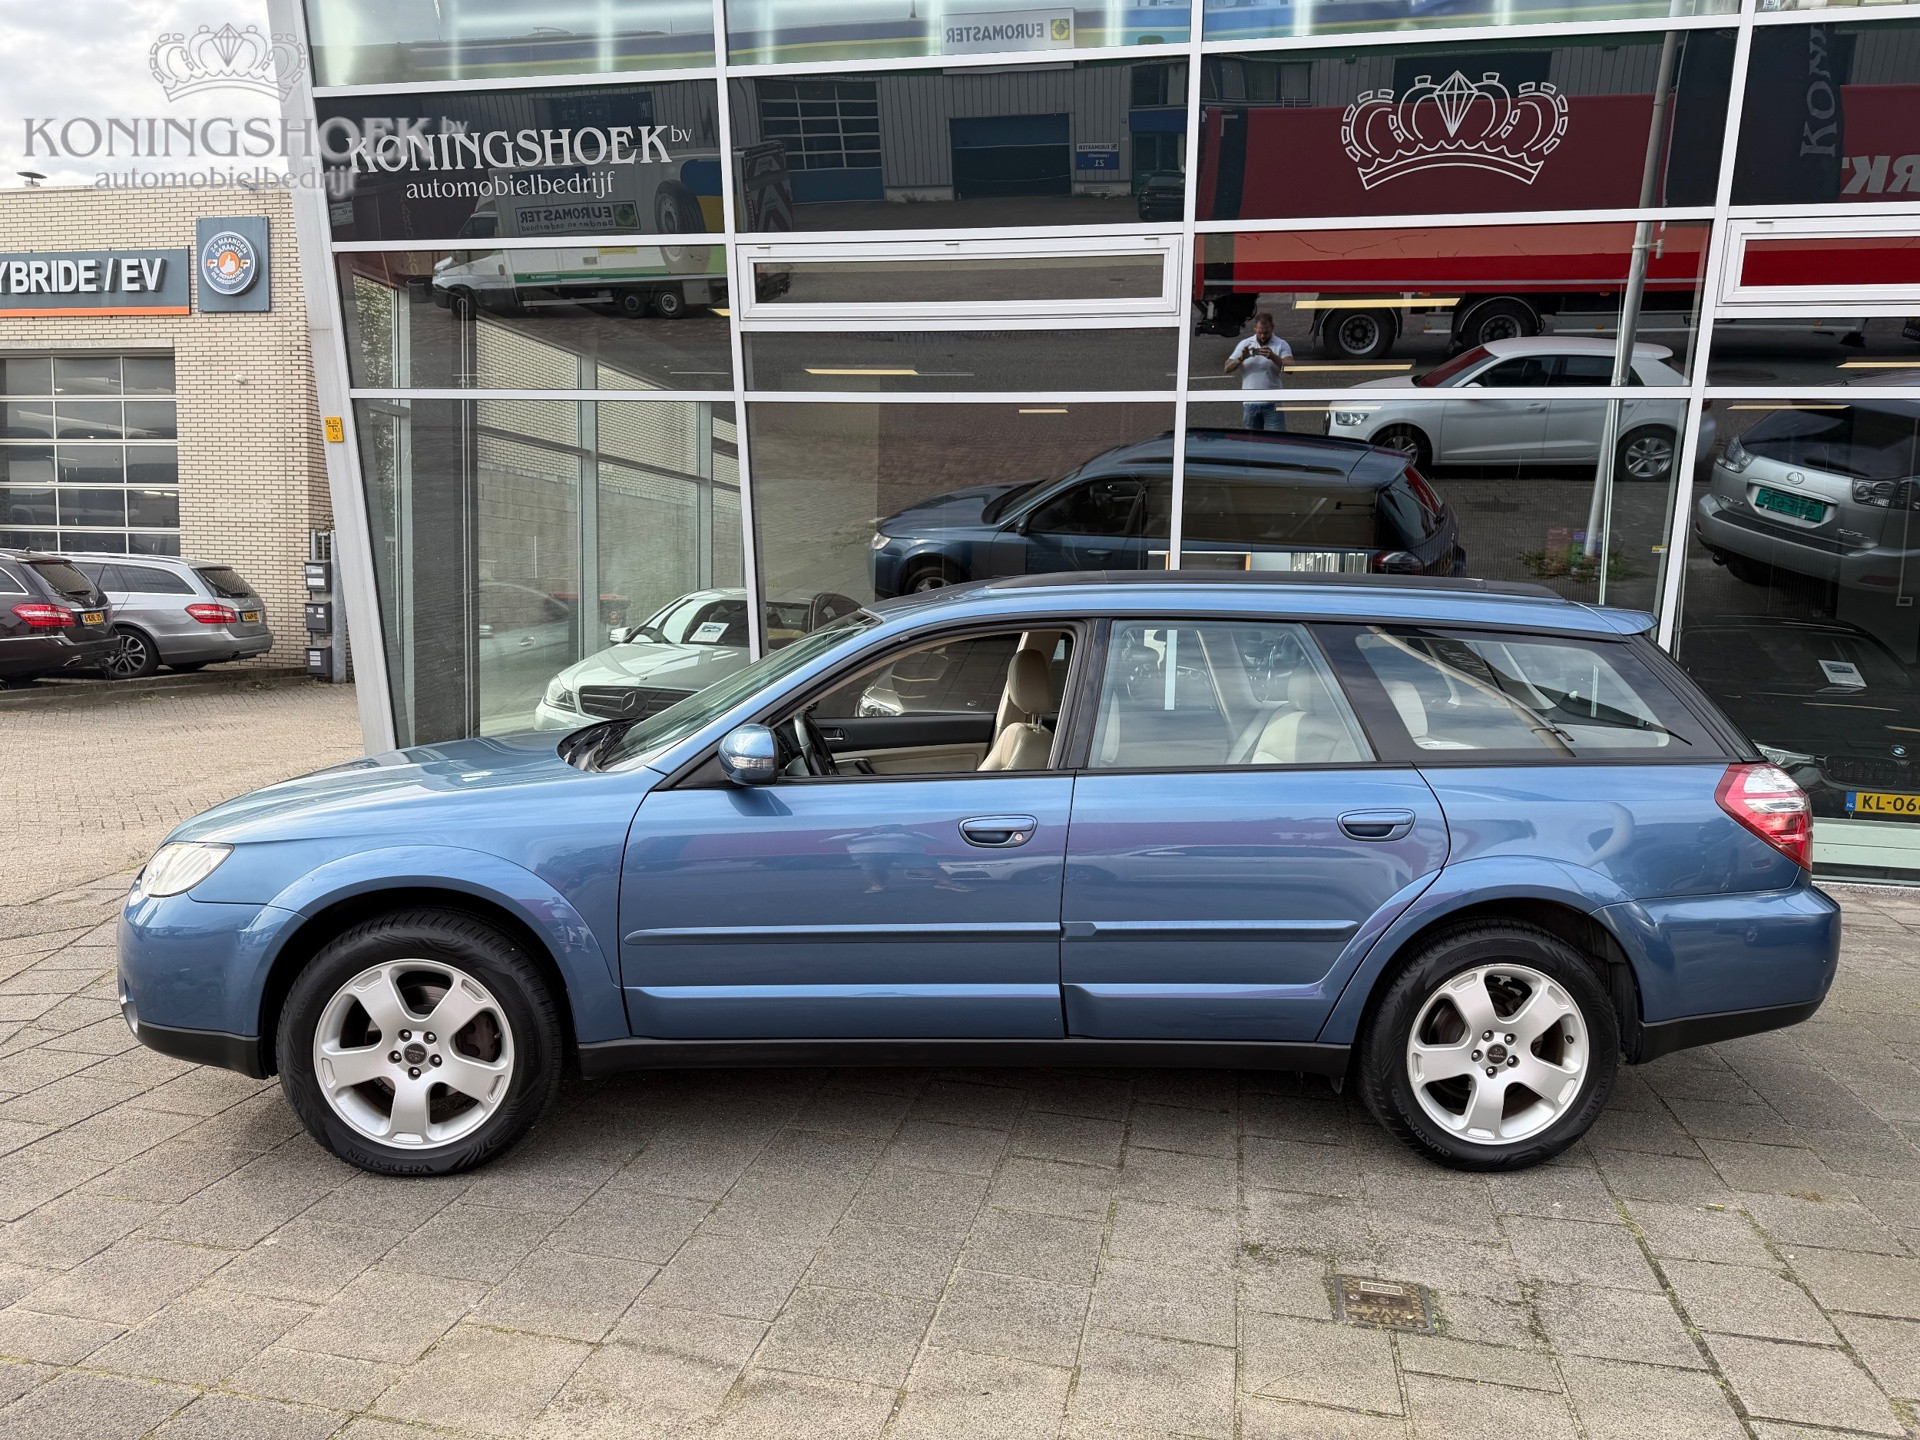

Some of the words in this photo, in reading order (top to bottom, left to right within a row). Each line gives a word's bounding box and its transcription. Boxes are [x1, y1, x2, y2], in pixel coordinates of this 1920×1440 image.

[345, 125, 672, 173] KONINGSHOEK
[671, 125, 692, 142] bv
[406, 171, 615, 199] automobielbedrijf
[215, 244, 244, 258] GARANTIE
[218, 237, 248, 254] MAANDEN
[121, 258, 164, 292] EV
[1862, 795, 1920, 812] KL-06
[1403, 1115, 1452, 1157] QUATRAC
[345, 1147, 435, 1174] VREDESTEIN
